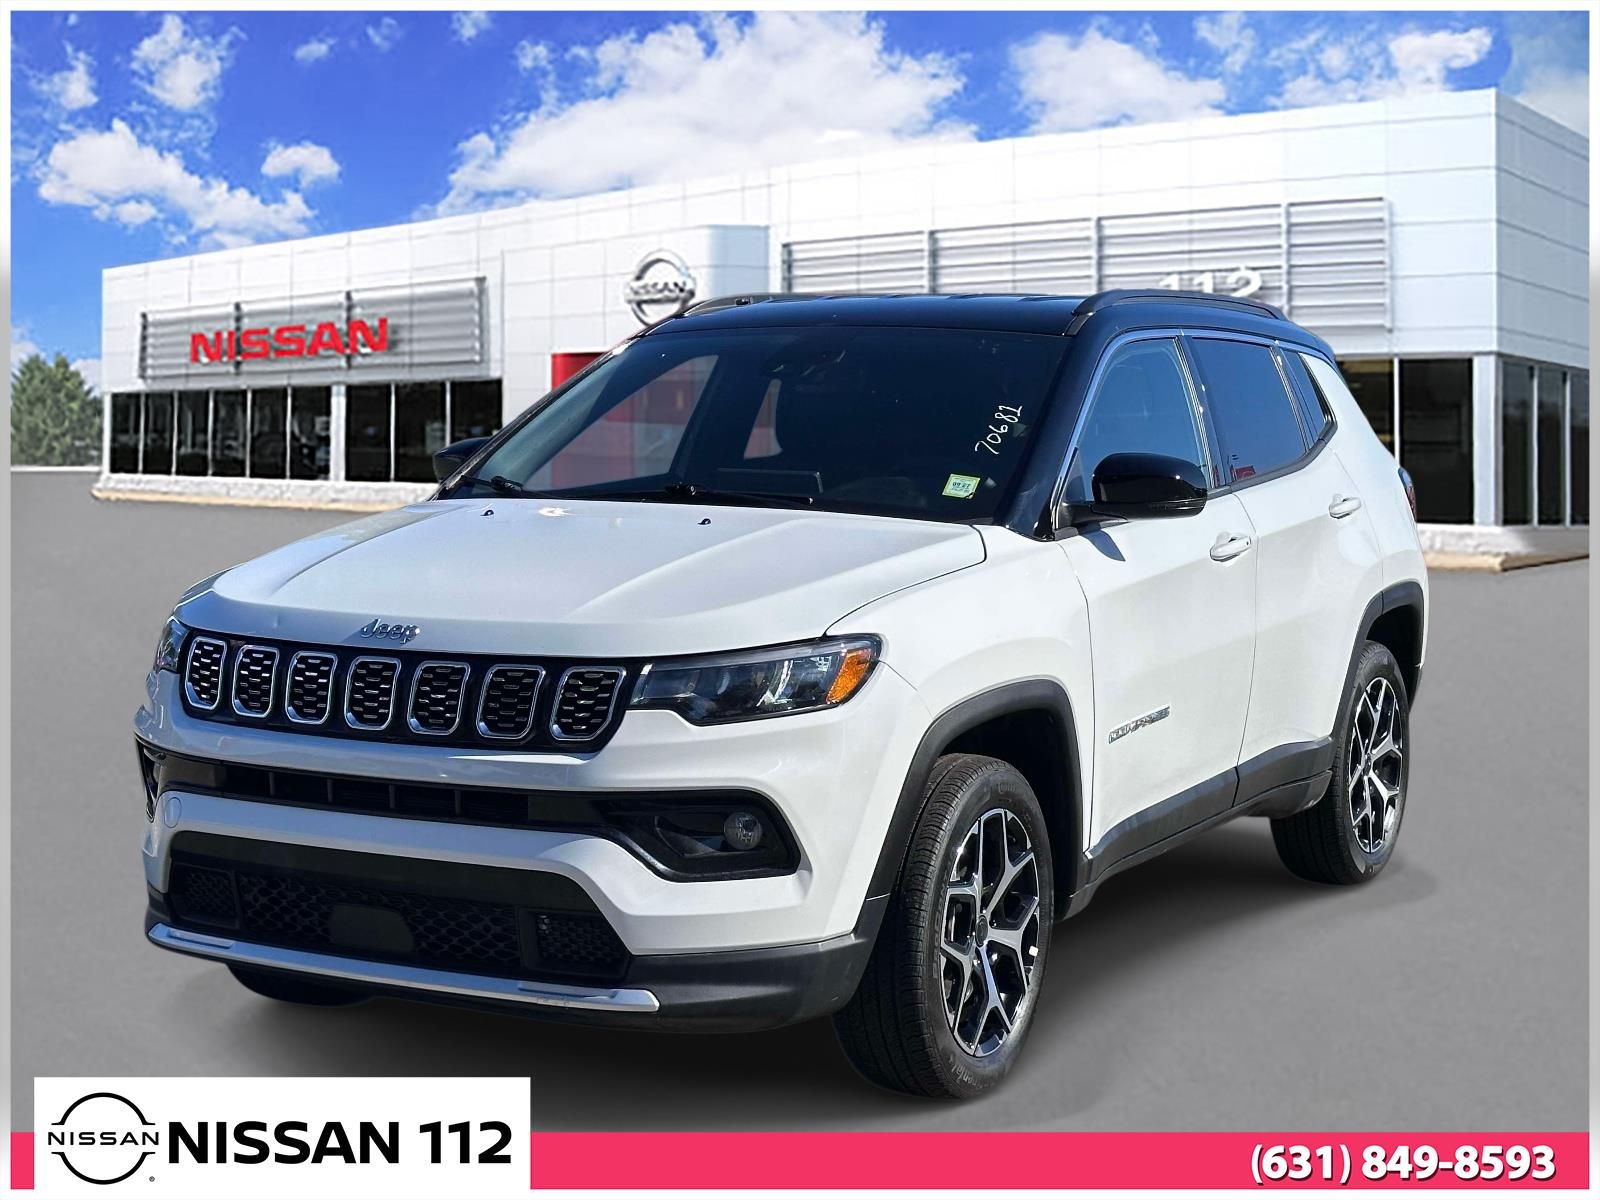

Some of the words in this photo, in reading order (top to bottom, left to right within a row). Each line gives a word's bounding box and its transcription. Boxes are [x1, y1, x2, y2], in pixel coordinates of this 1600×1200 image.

[1158, 268, 1262, 298] 112
[190, 316, 389, 363] NISSAN
[974, 405, 1023, 455] 70681
[359, 618, 421, 645] Jeep
